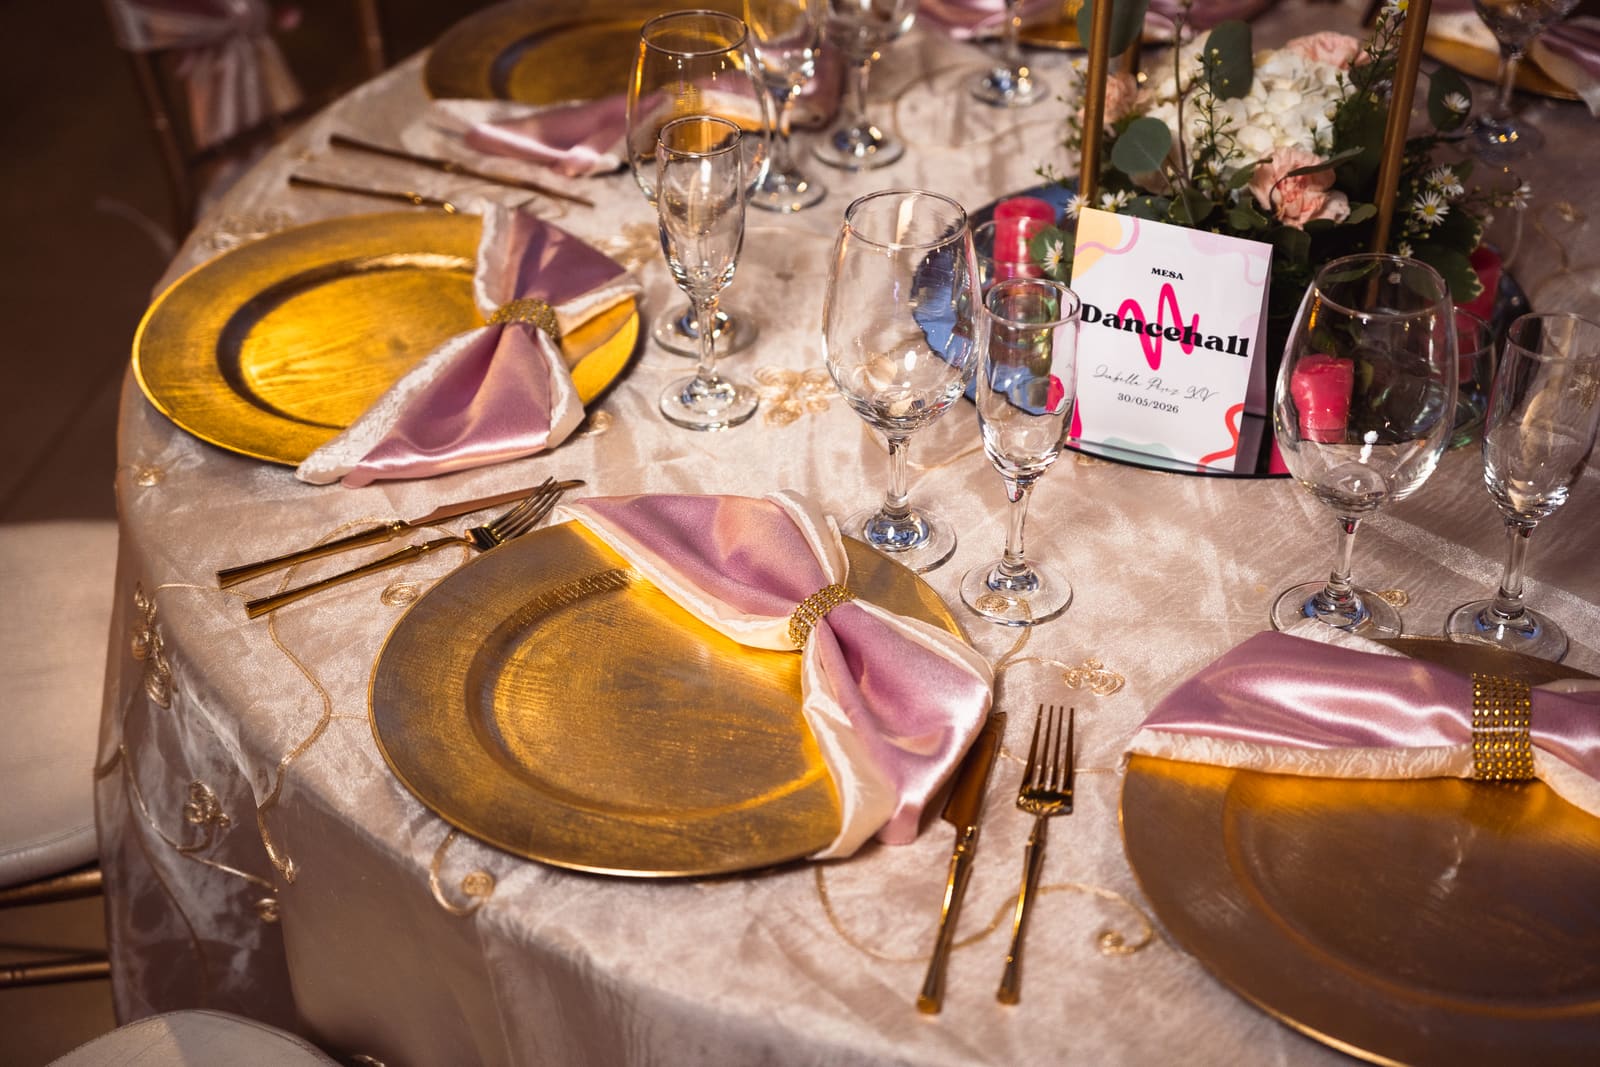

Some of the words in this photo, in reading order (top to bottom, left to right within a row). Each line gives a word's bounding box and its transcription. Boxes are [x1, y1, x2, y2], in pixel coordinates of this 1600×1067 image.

[1151, 267, 1184, 280] MESA
[1080, 303, 1250, 357] Dancehall
[1117, 392, 1179, 414] 30/05/2026
